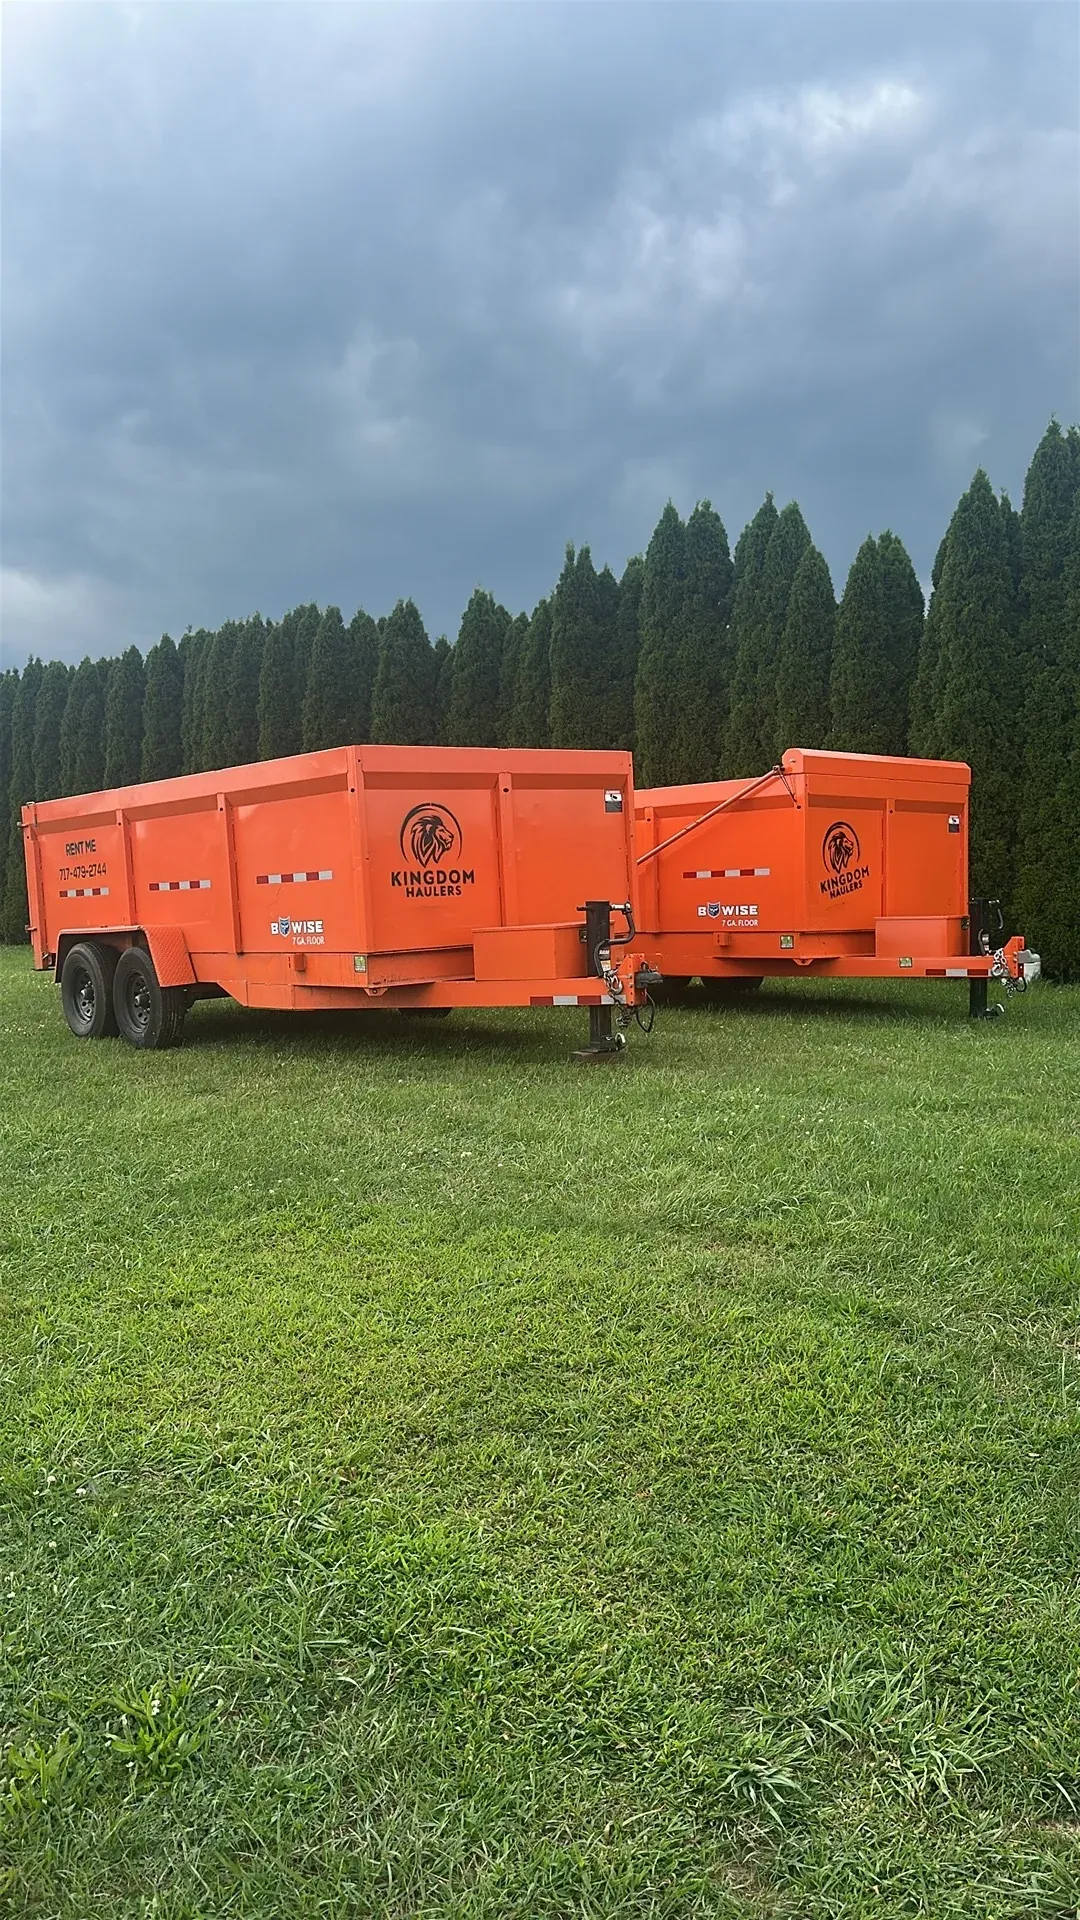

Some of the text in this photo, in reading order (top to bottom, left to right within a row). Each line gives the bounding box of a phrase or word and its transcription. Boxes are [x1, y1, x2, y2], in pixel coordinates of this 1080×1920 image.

[65, 839, 96, 856] RENT ME
[59, 862, 107, 881] 717-479-2744
[391, 869, 475, 886] KINGDOM
[820, 865, 870, 894] KINGDOM
[406, 885, 462, 898] HAULERS
[829, 879, 863, 899] HAULERS
[722, 919, 726, 927] 7
[738, 919, 759, 927] FLOOR
[292, 936, 297, 945] 7
[306, 936, 325, 946] FLOOR
